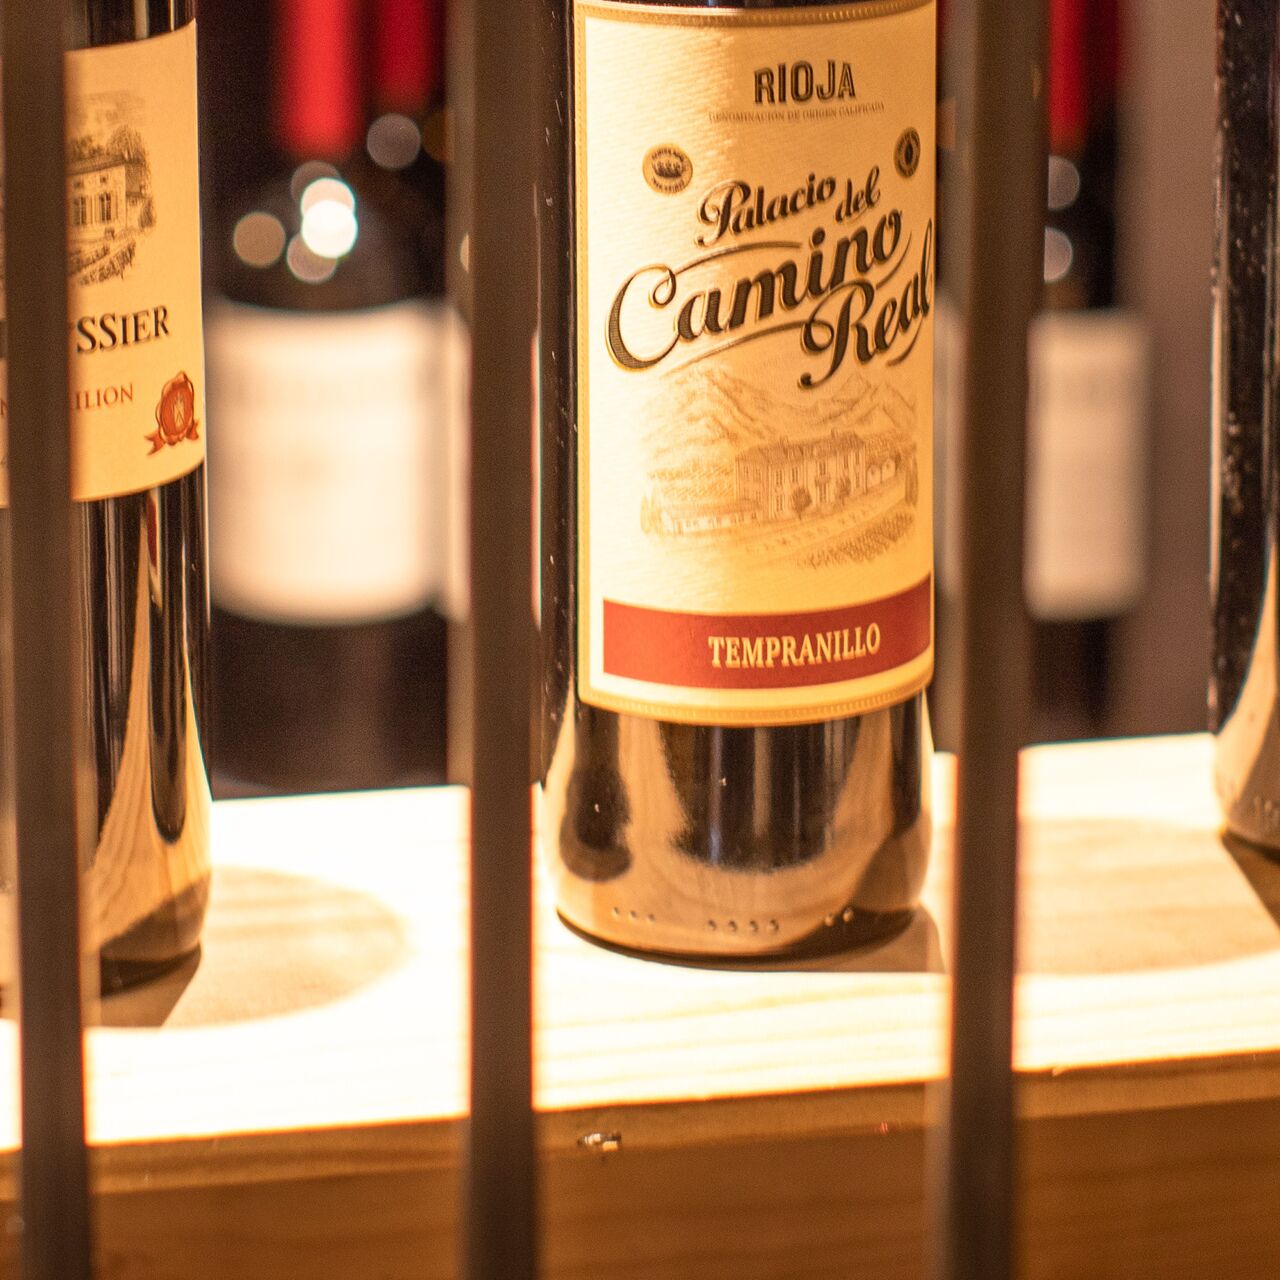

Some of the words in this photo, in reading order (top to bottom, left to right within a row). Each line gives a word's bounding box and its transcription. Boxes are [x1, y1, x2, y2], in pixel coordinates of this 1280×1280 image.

[753, 60, 857, 106] RIOJA
[694, 173, 836, 247] Palacio
[834, 165, 881, 223] del
[606, 209, 904, 373] Camino
[797, 218, 934, 389] Real
[707, 622, 881, 670] TEMPRANILLO
